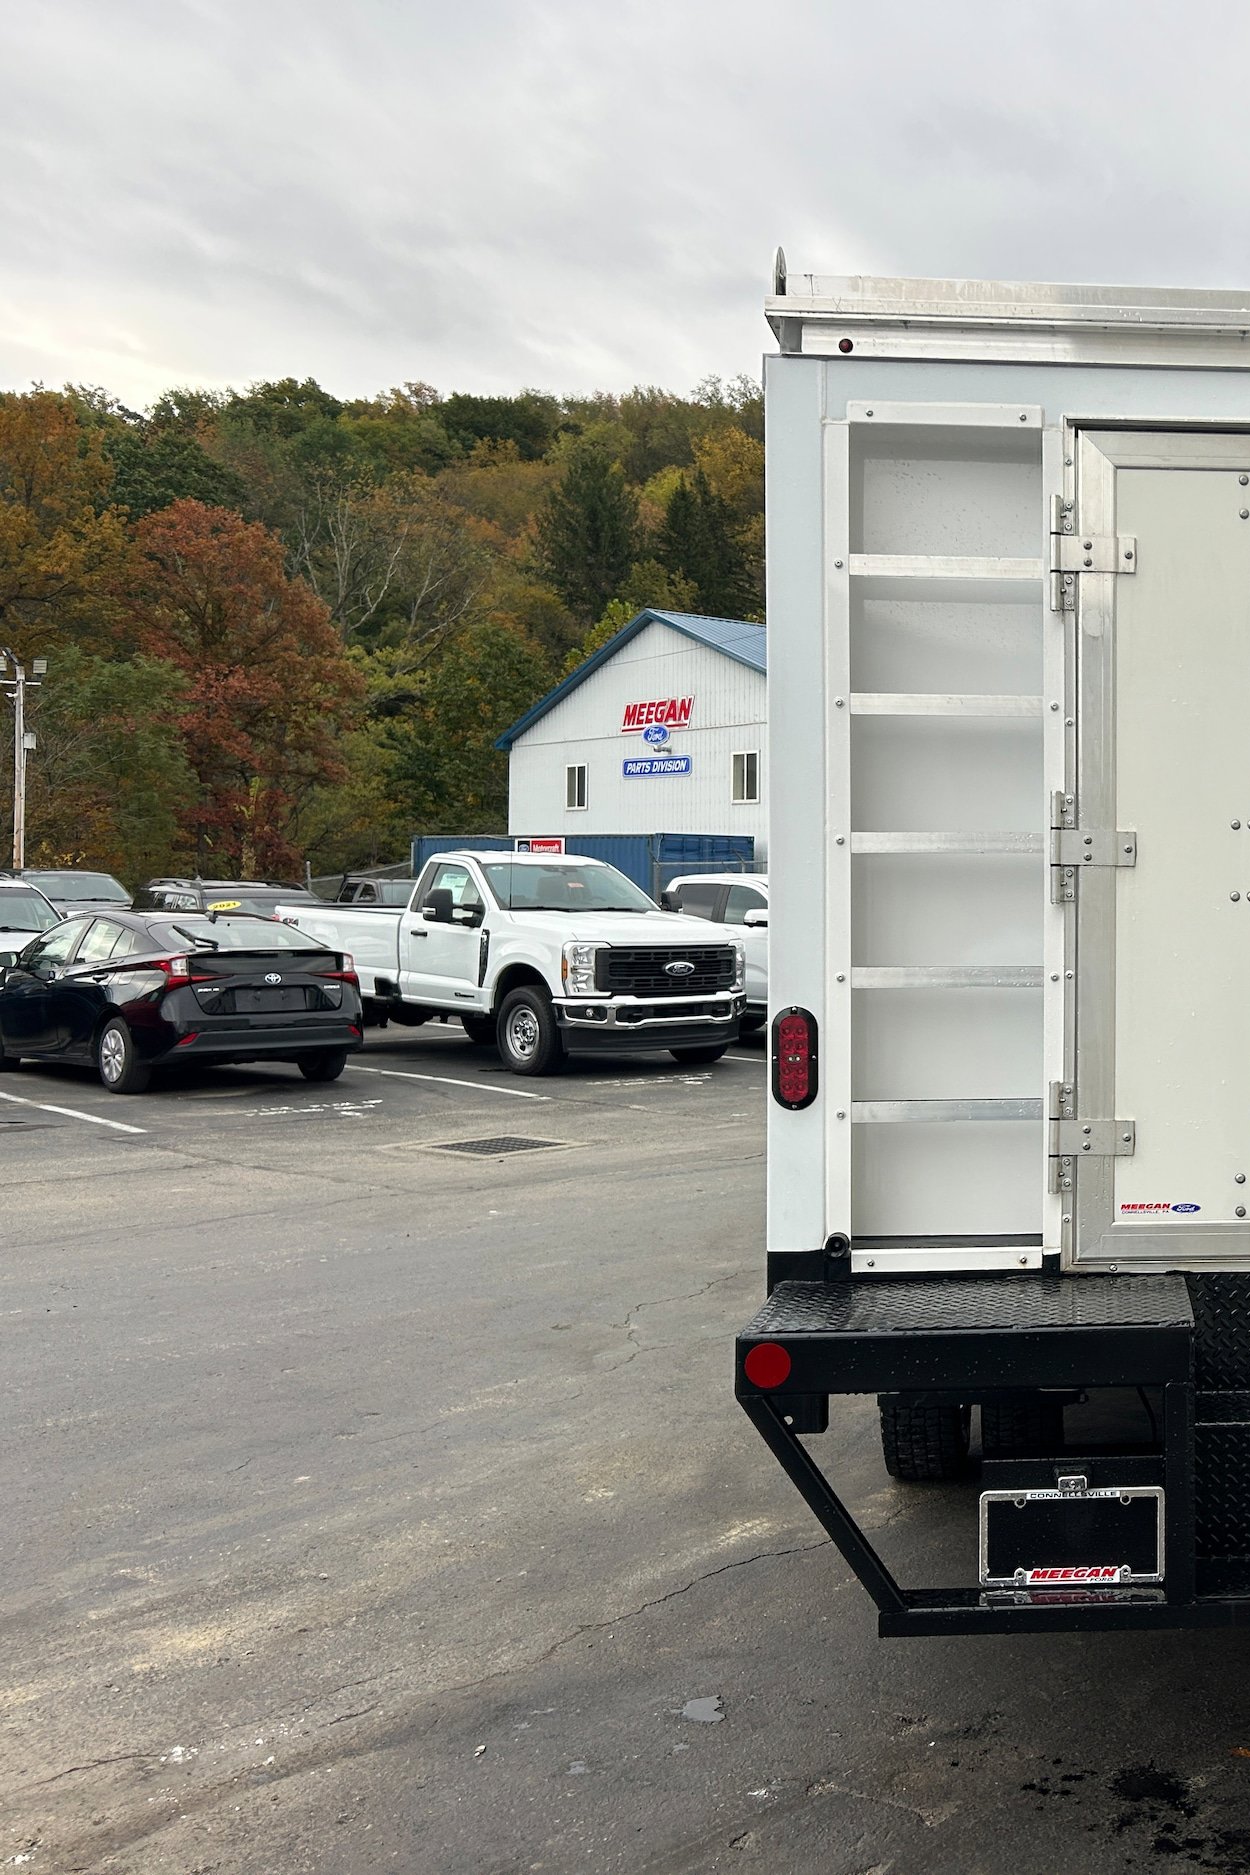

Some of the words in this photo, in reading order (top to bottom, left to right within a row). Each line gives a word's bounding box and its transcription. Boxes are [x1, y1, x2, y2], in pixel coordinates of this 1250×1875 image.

[623, 698, 692, 726] MEEGAN
[647, 727, 664, 741] Ford
[626, 762, 651, 773] PARTS
[652, 760, 687, 772] DIVISION
[1176, 1204, 1195, 1212] Ford
[1030, 1568, 1117, 1579] MEEGAN
